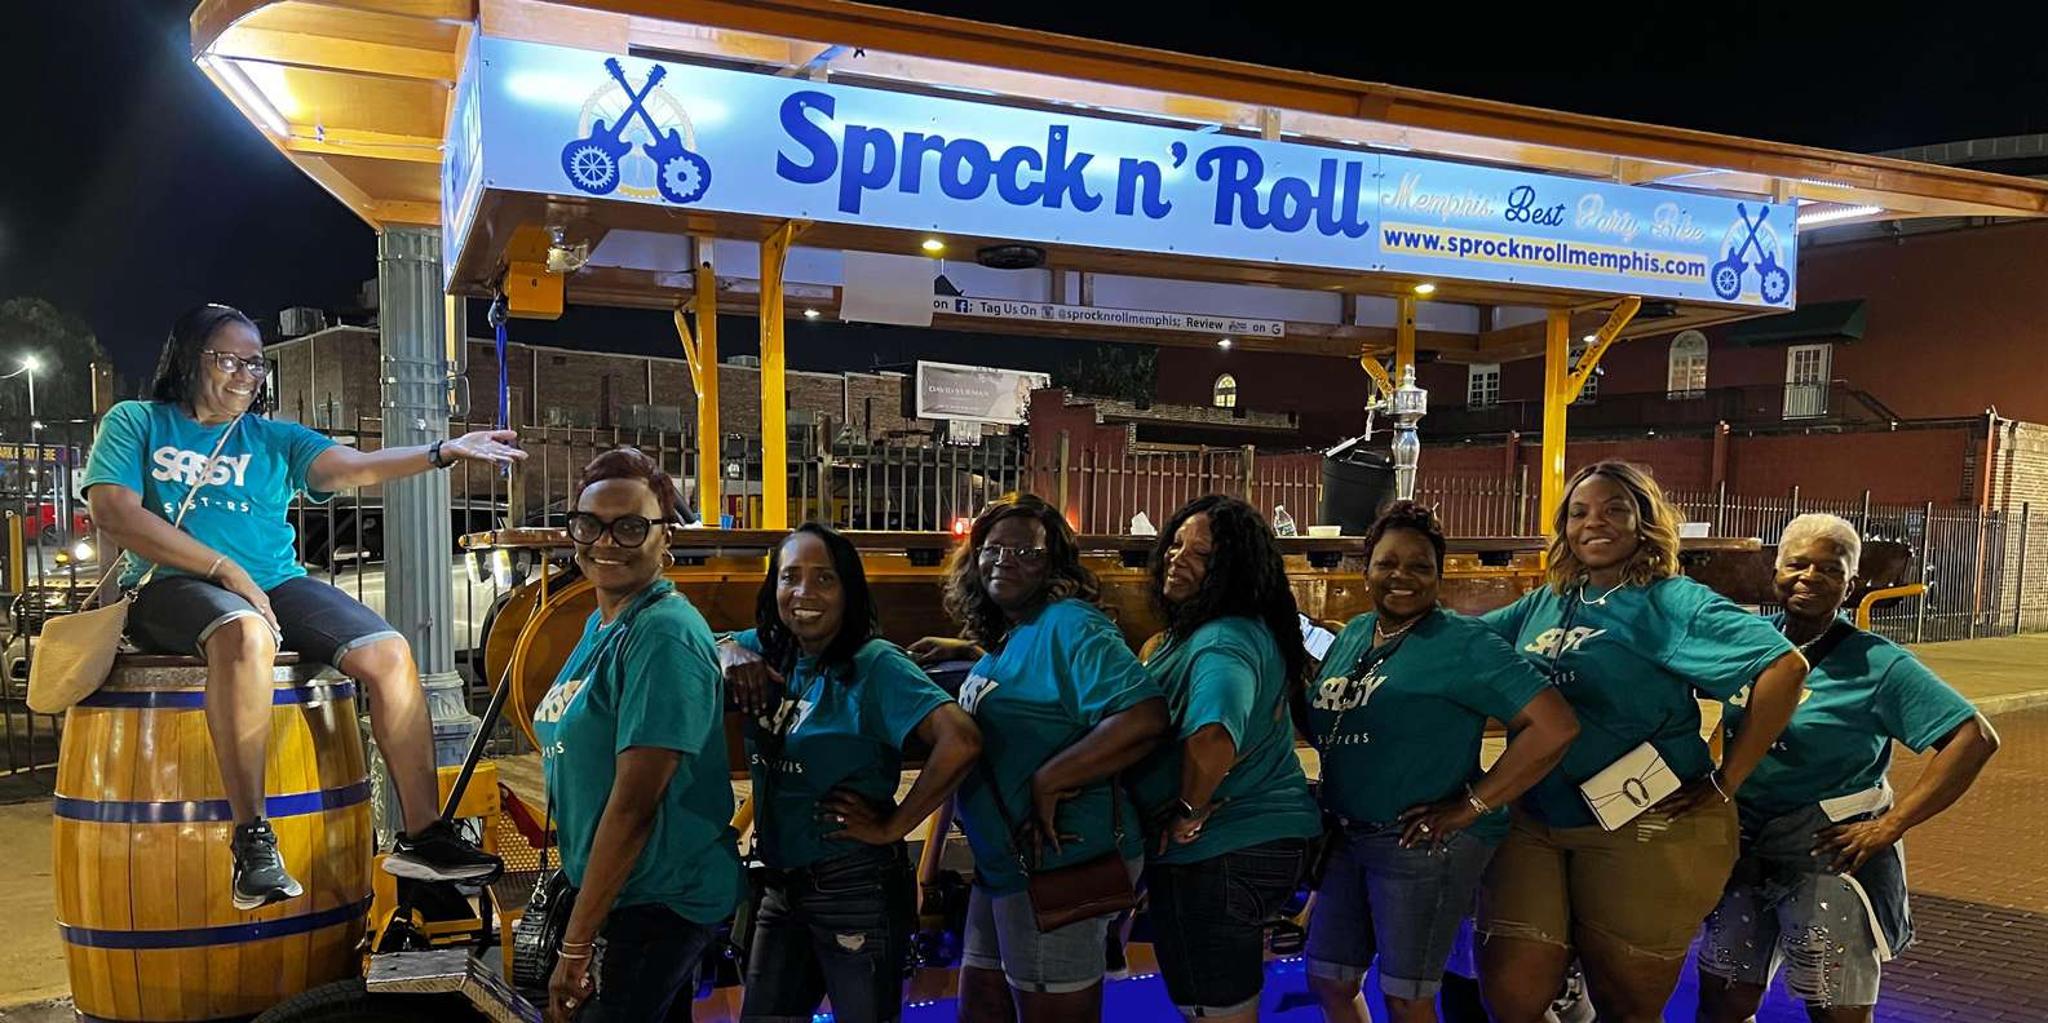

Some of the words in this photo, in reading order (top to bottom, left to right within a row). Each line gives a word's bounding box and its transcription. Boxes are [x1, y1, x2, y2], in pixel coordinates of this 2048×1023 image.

[776, 90, 1103, 214] Sprock
[1196, 145, 1370, 238] Roll
[1505, 185, 1566, 227] Best
[1384, 230, 1706, 277] www.sprocknrollmemphis.com
[933, 299, 948, 309] on
[980, 302, 1001, 315] Tag
[1003, 303, 1018, 314] Us
[1020, 305, 1037, 316] On
[1186, 317, 1224, 329] Review
[1252, 323, 1266, 332] on
